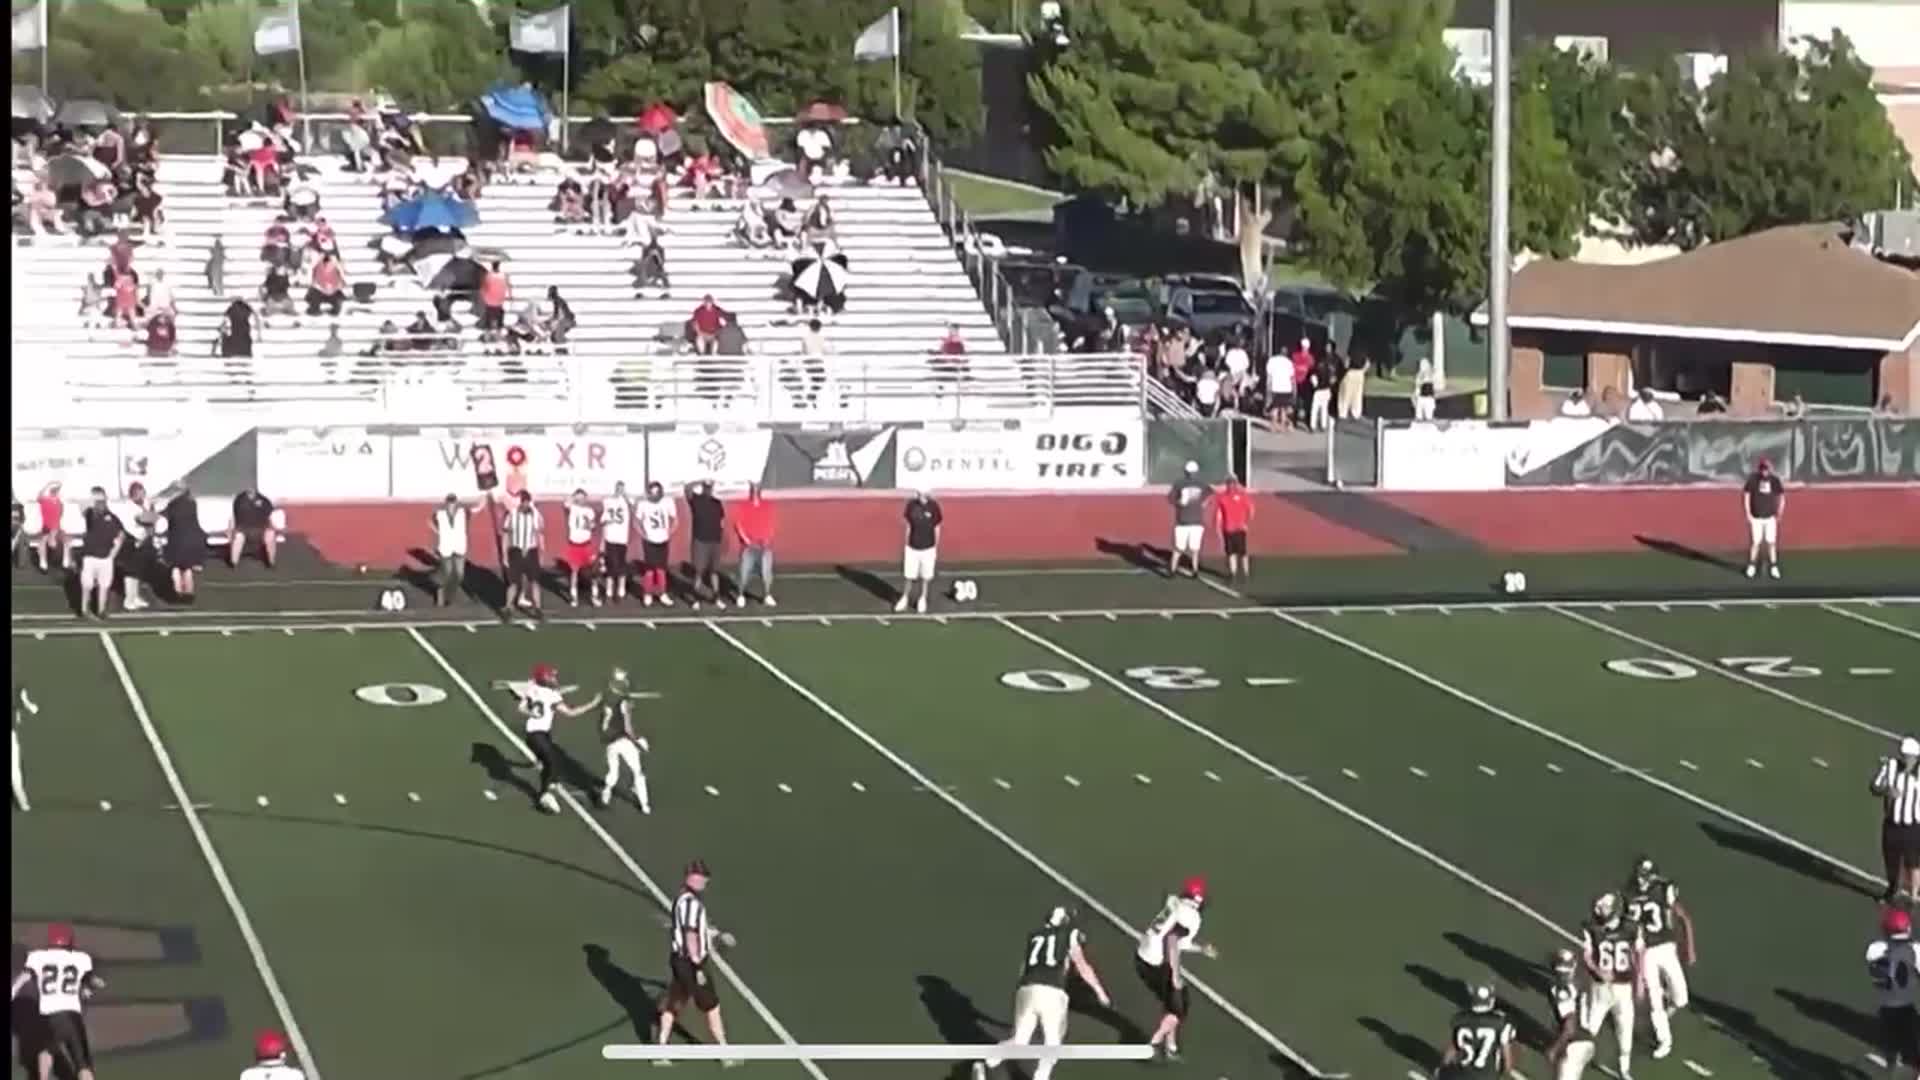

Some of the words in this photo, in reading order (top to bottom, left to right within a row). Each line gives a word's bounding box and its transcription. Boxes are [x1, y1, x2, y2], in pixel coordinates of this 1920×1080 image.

[1036, 433, 1092, 451] BIG
[1037, 463, 1128, 478] TIRES
[1029, 934, 1057, 966] 71
[1599, 940, 1630, 972] 66
[42, 963, 79, 995] 22
